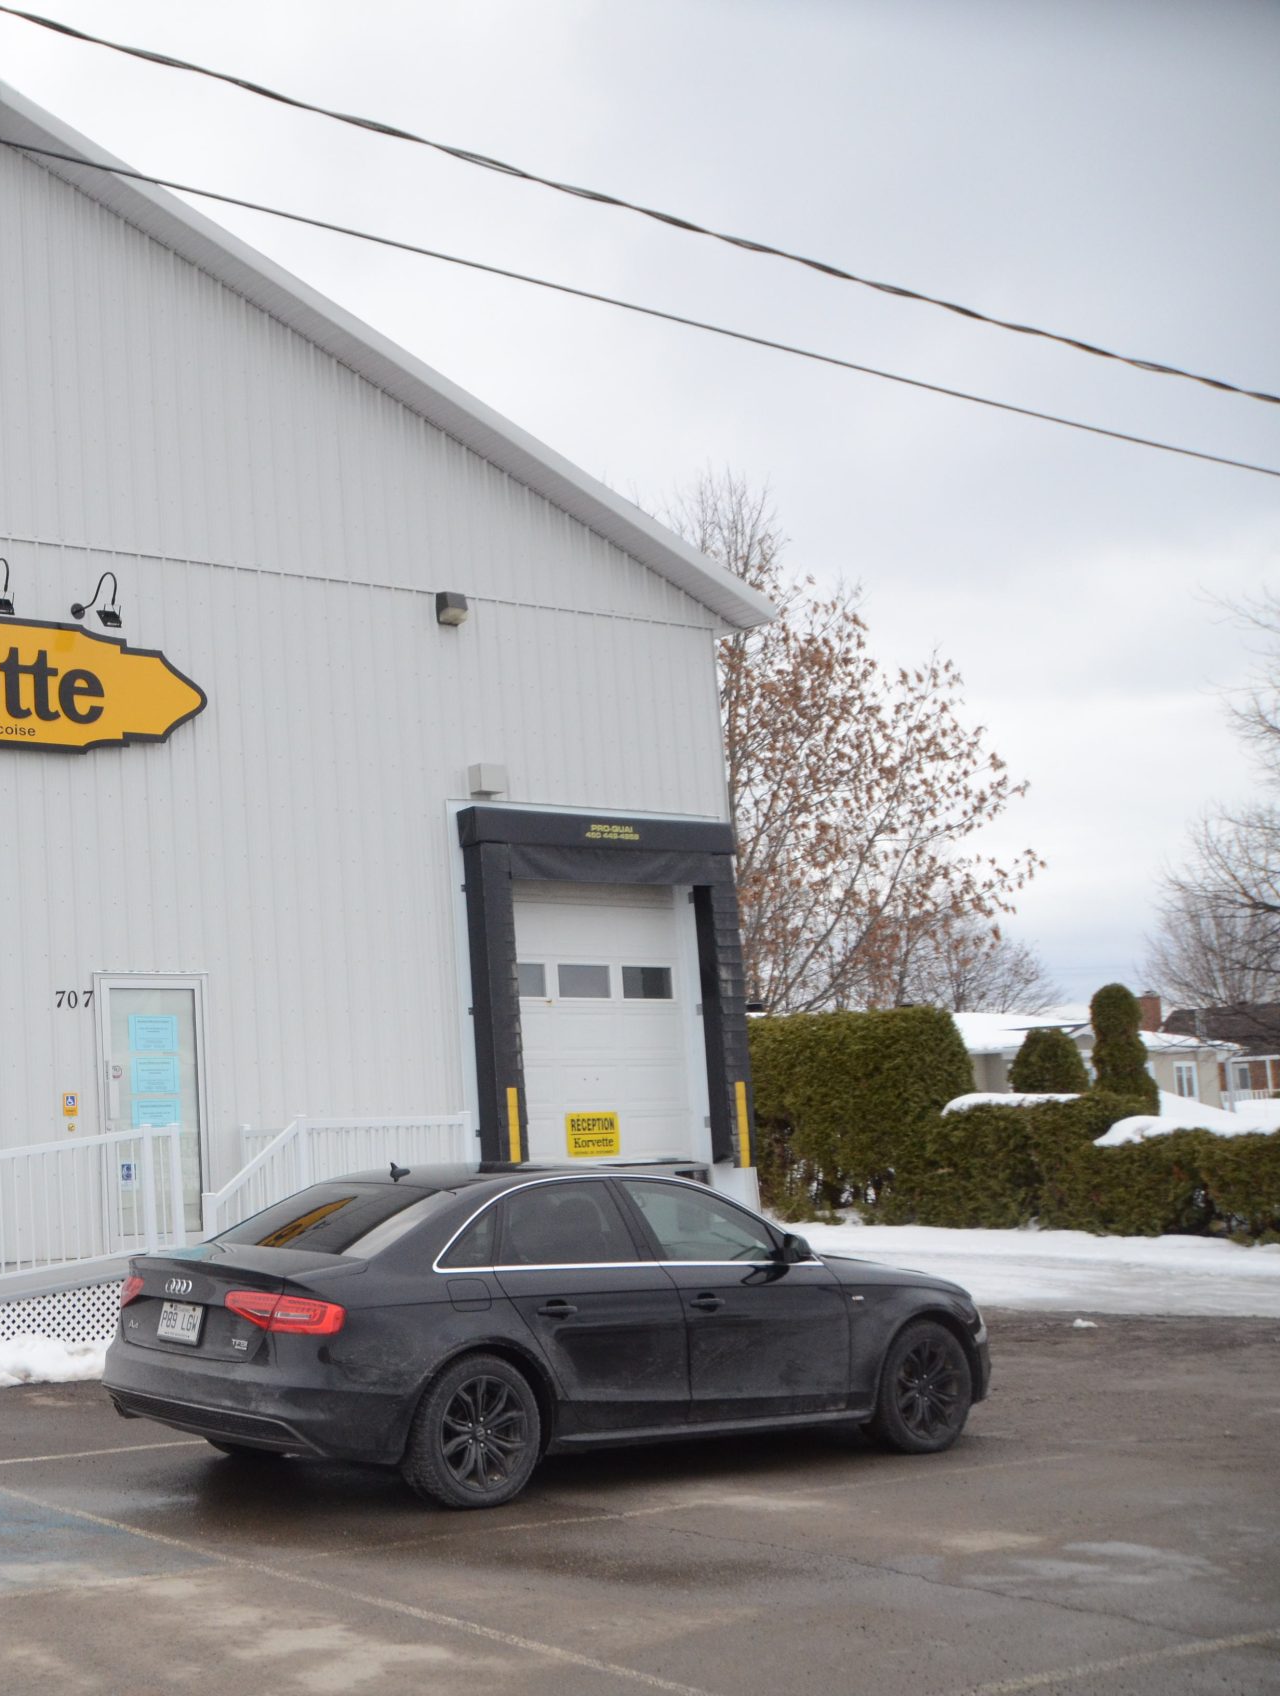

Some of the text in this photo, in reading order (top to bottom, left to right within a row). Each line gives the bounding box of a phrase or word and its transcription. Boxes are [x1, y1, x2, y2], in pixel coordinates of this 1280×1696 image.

[55, 990, 94, 1009] 707
[574, 1137, 614, 1148] Korvette
[181, 1313, 199, 1332] LGW
